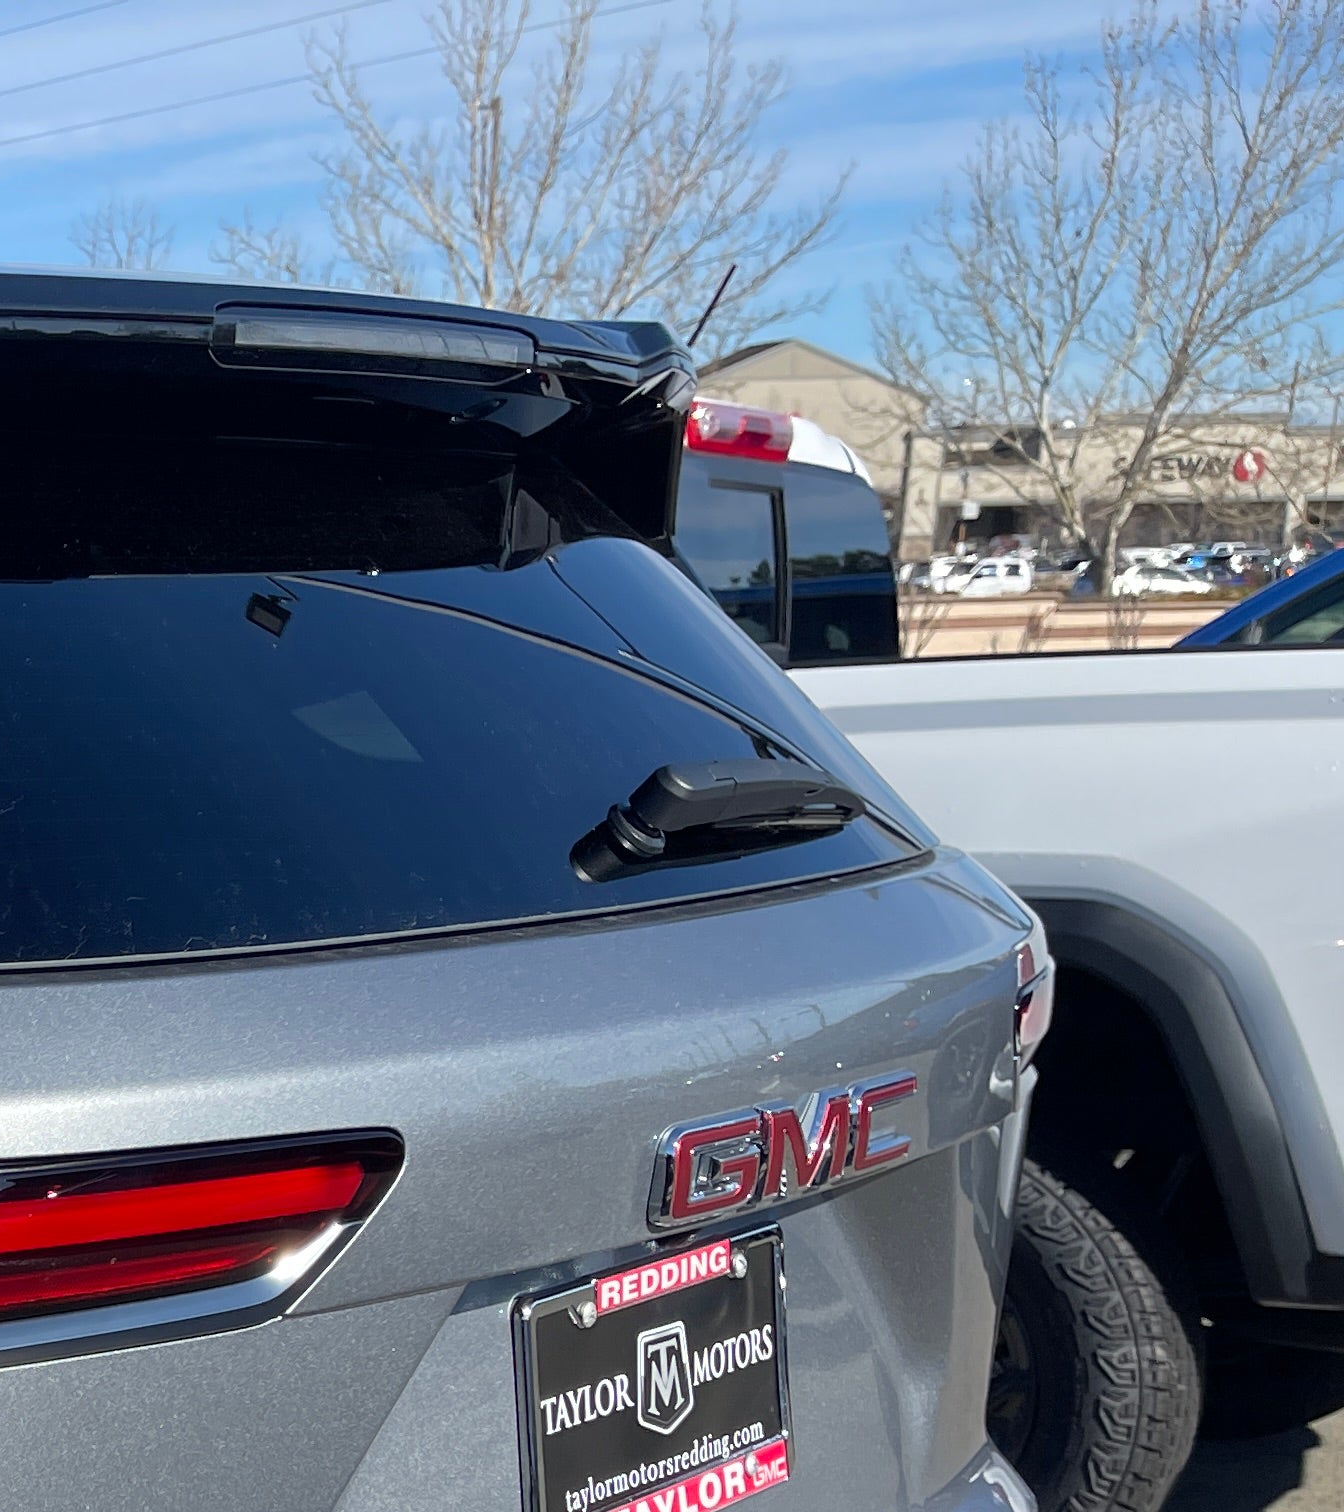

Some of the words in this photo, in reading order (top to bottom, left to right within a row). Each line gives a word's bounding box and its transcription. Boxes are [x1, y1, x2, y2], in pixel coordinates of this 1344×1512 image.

[1112, 453, 1231, 481] SFEWAY
[650, 1070, 917, 1231] GMC
[600, 1246, 728, 1309] REDDING
[540, 1373, 635, 1435] TAYLOR
[692, 1324, 774, 1386] MOTORS
[752, 1456, 787, 1488] GMC
